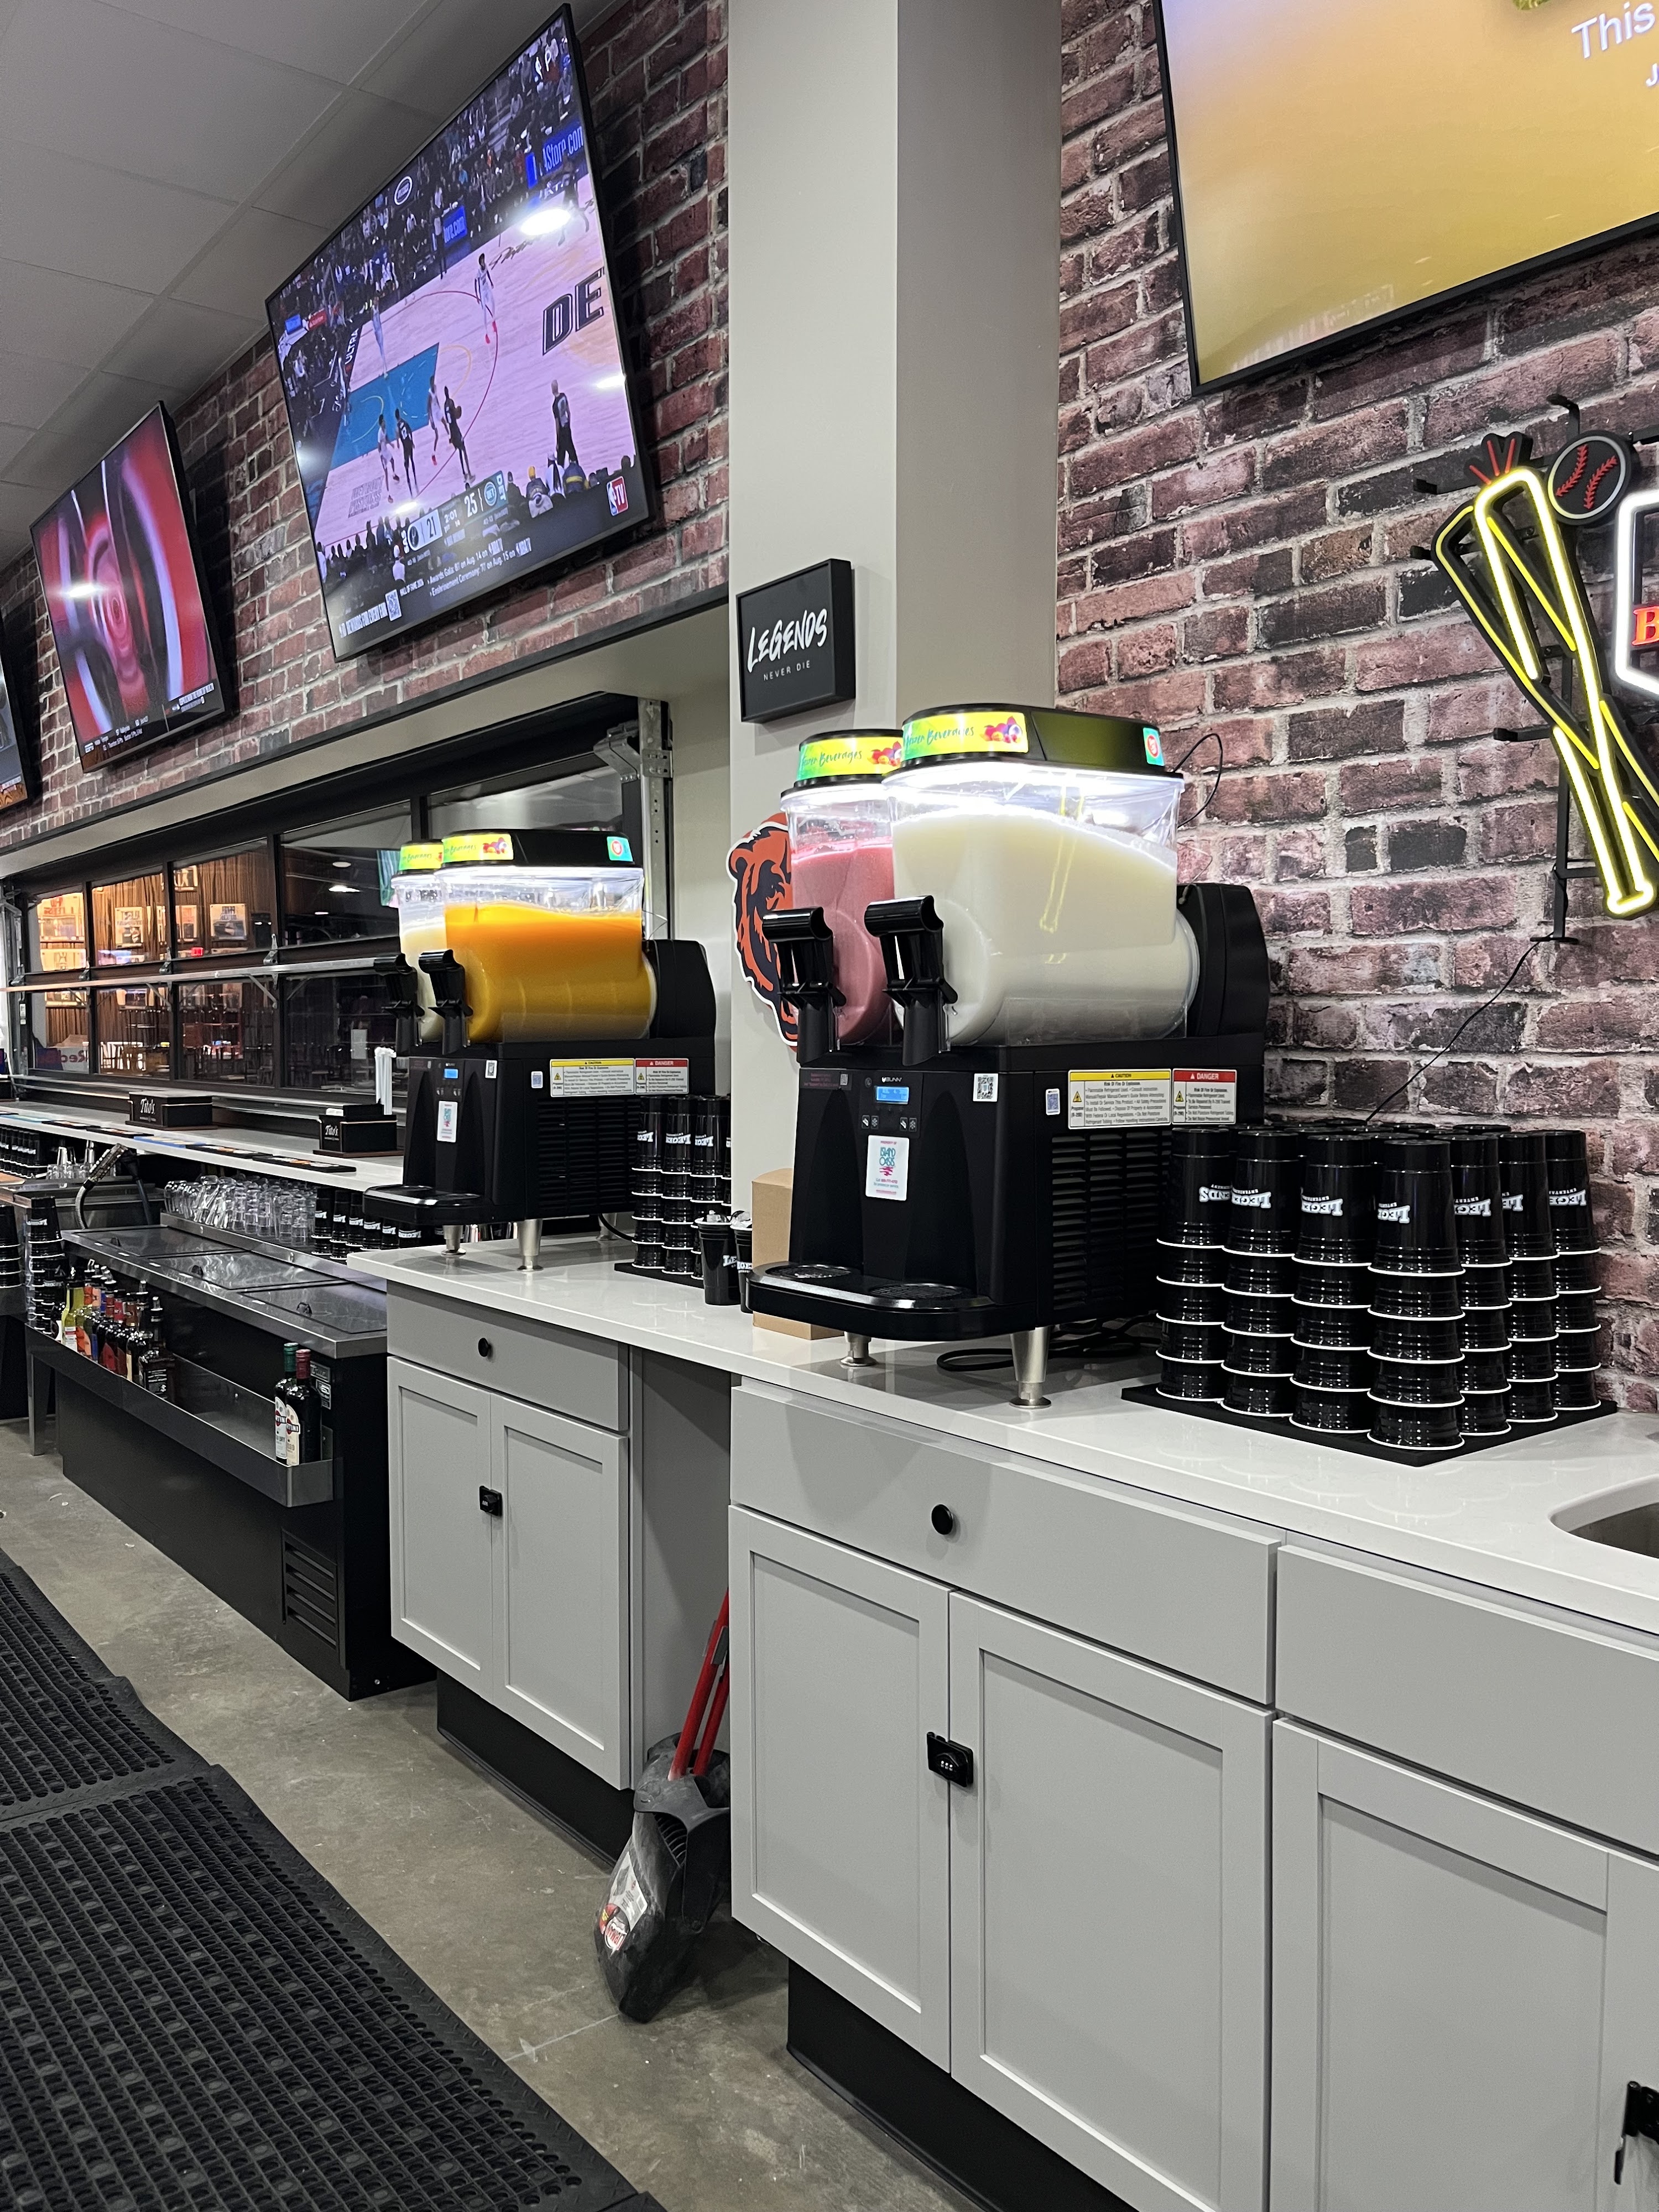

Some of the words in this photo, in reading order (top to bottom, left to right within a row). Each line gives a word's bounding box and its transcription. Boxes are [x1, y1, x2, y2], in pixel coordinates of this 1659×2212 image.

[1571, 1, 1656, 59] This
[543, 267, 604, 356] DE
[497, 474, 507, 500] DET
[444, 509, 458, 522] 2:01
[465, 493, 478, 518] 25
[427, 516, 437, 539] 21
[747, 608, 827, 673] LEGENDS
[763, 666, 791, 681] NEVER
[796, 660, 811, 671] DIE
[819, 750, 862, 767] Beverages
[140, 1097, 155, 1114] Tito's
[325, 1125, 338, 1136] Tito's
[879, 1156, 895, 1167] OASIS
[880, 1147, 896, 1157] ISLAND
